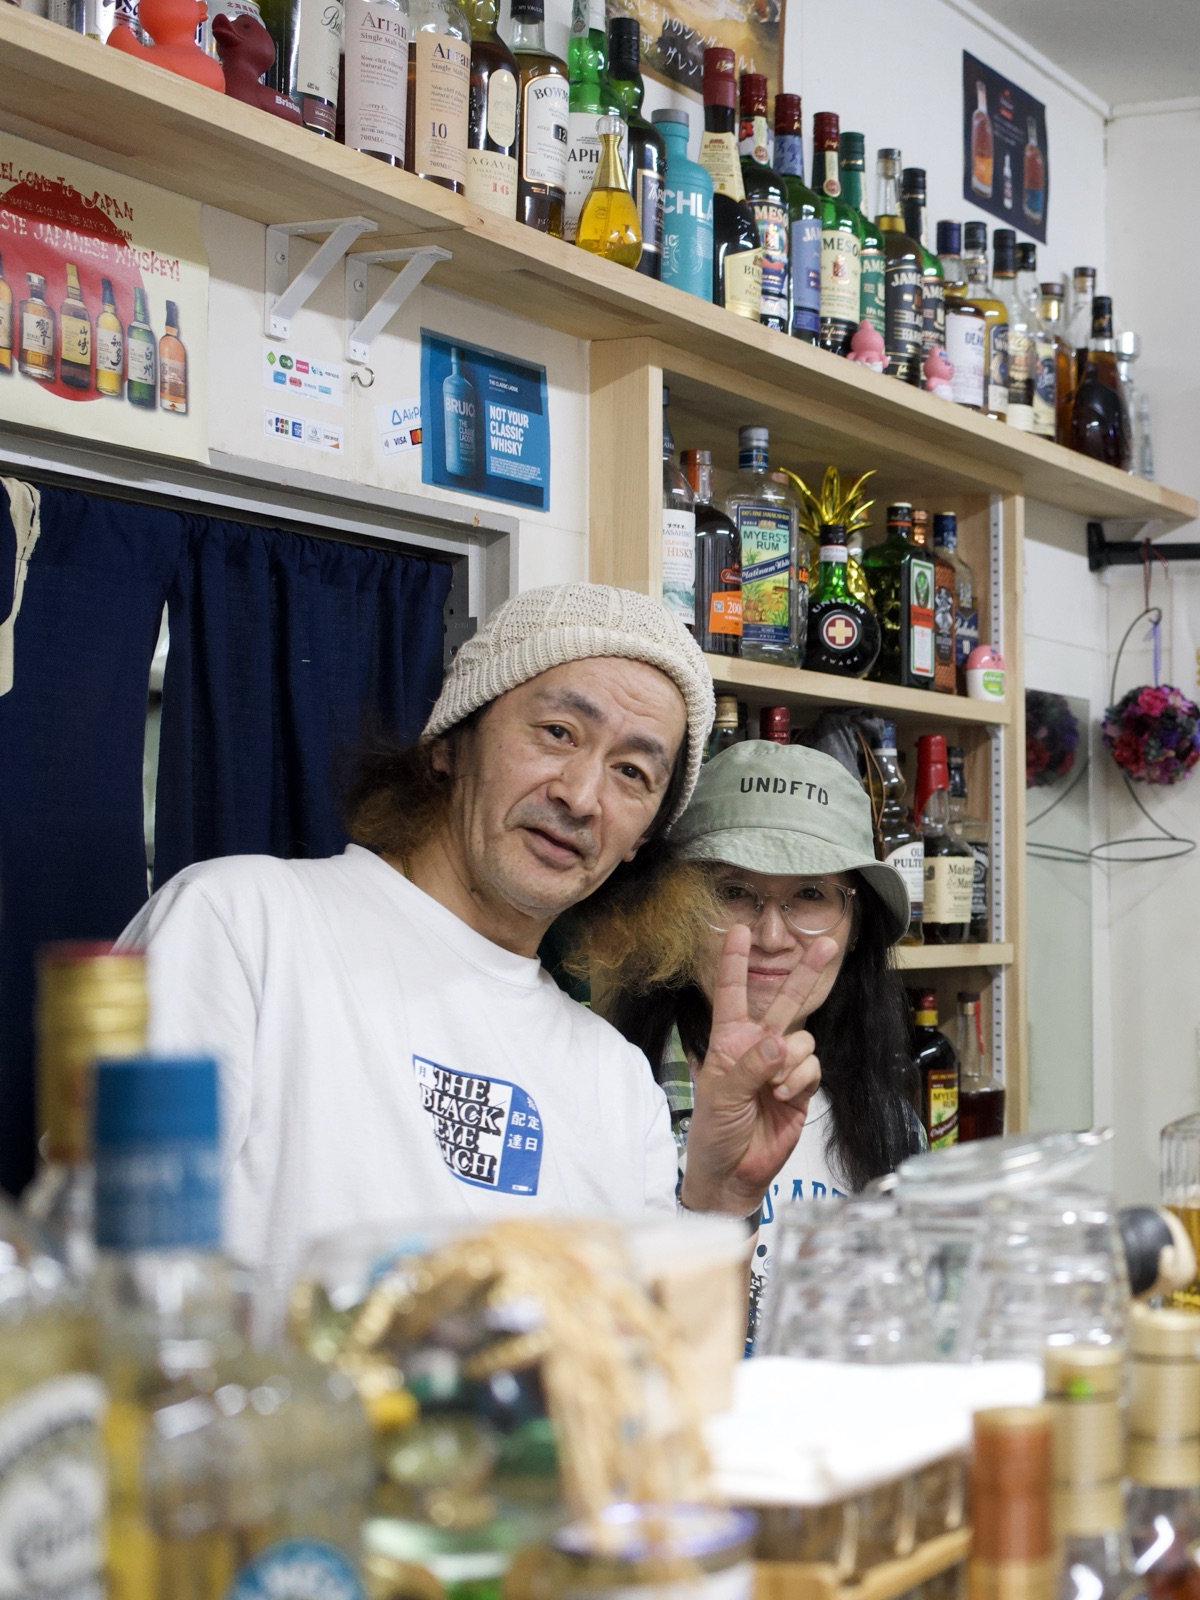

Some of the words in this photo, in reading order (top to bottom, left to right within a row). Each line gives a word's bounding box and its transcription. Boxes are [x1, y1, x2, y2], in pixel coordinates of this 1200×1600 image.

[360, 11, 407, 41] Arran
[360, 32, 383, 42] Single
[431, 122, 448, 139] 10
[0, 162, 53, 192] ELCOME
[81, 190, 134, 222] JAPAN
[490, 181, 510, 196] 16
[34, 222, 109, 260] JAPANESE
[115, 243, 181, 282] WHISKEY!
[489, 405, 506, 422] NOT
[508, 409, 529, 428] YOUR
[490, 420, 524, 441] CLASSIC
[393, 438, 407, 446] VISA
[490, 436, 523, 456] WHISKY
[743, 530, 788, 544] MYERS'S
[756, 540, 780, 552] RUM
[663, 546, 693, 559] HISKY
[811, 597, 867, 615] UNICUM
[740, 777, 829, 806] UNDFTD
[434, 1066, 488, 1102] THE
[421, 1083, 500, 1132] BLACK
[433, 1114, 477, 1150] EYE
[506, 1111, 526, 1150] 配達
